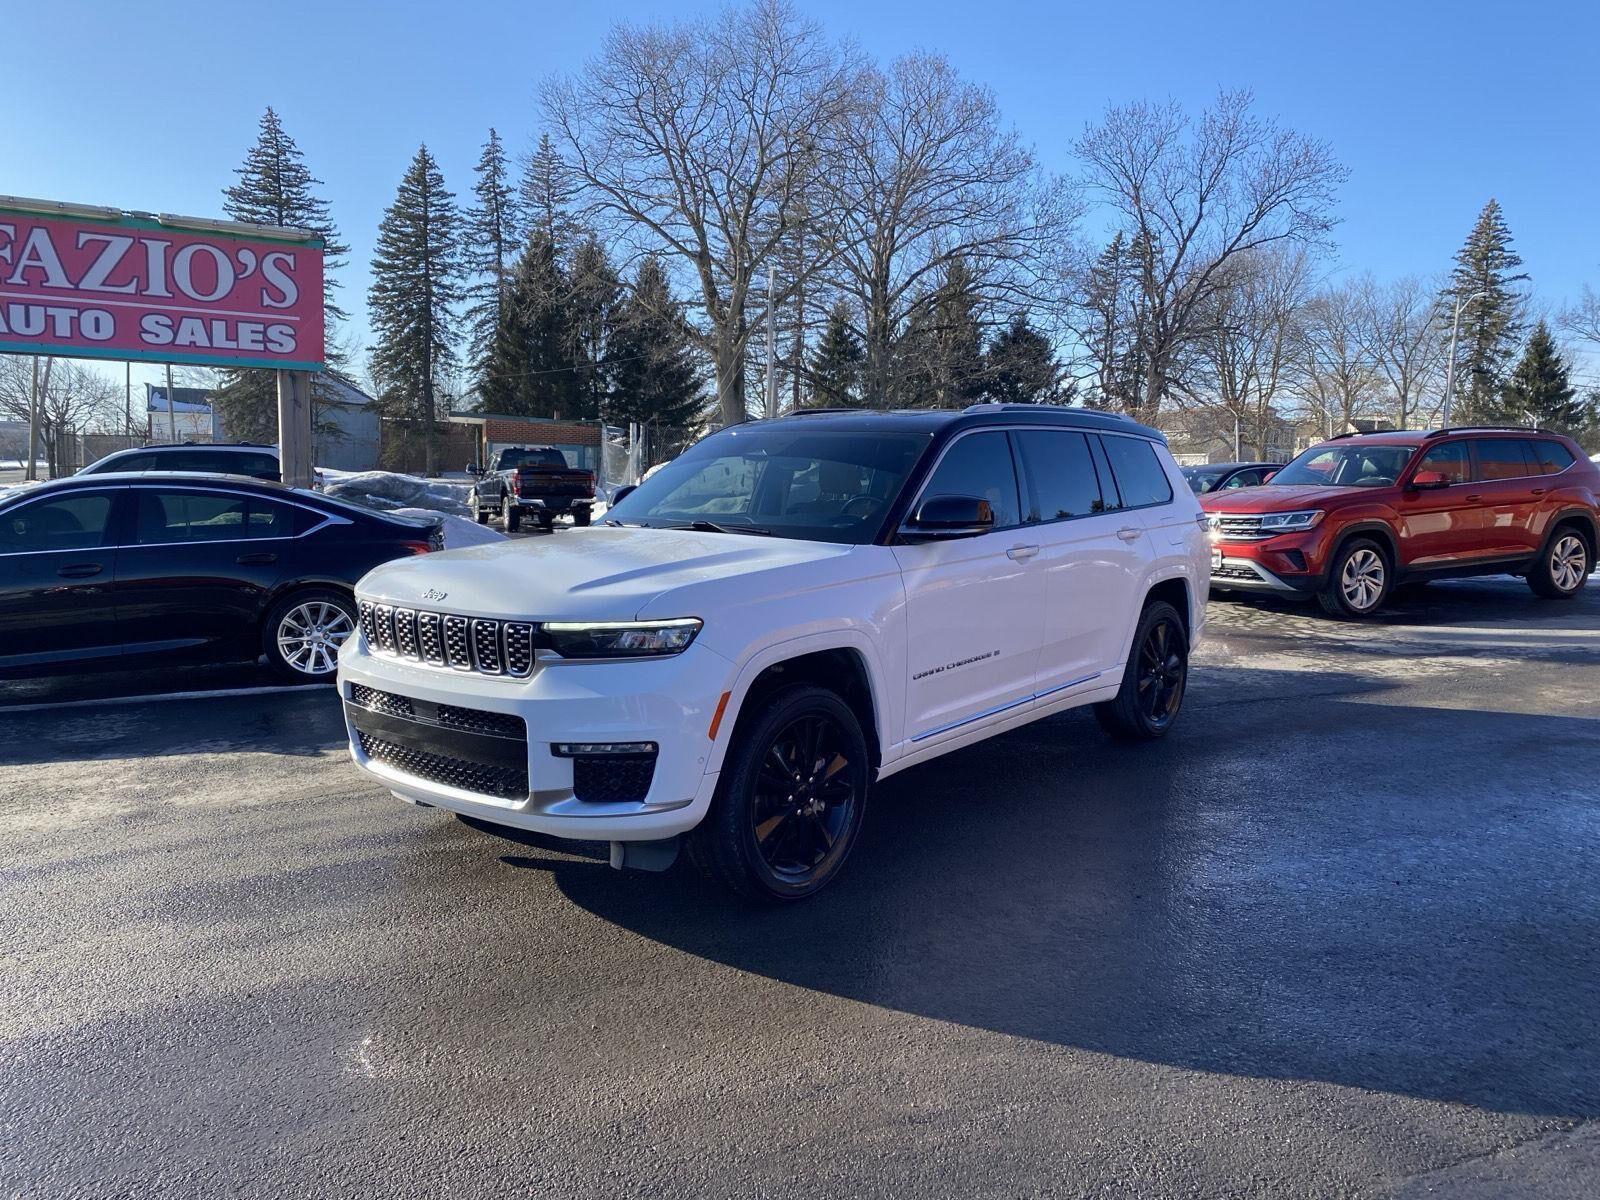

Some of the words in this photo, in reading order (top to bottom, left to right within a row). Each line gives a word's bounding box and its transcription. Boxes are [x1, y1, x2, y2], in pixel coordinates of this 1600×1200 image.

[0, 301, 116, 341] UTO
[139, 312, 298, 354] SALES
[422, 588, 448, 602] Jeep
